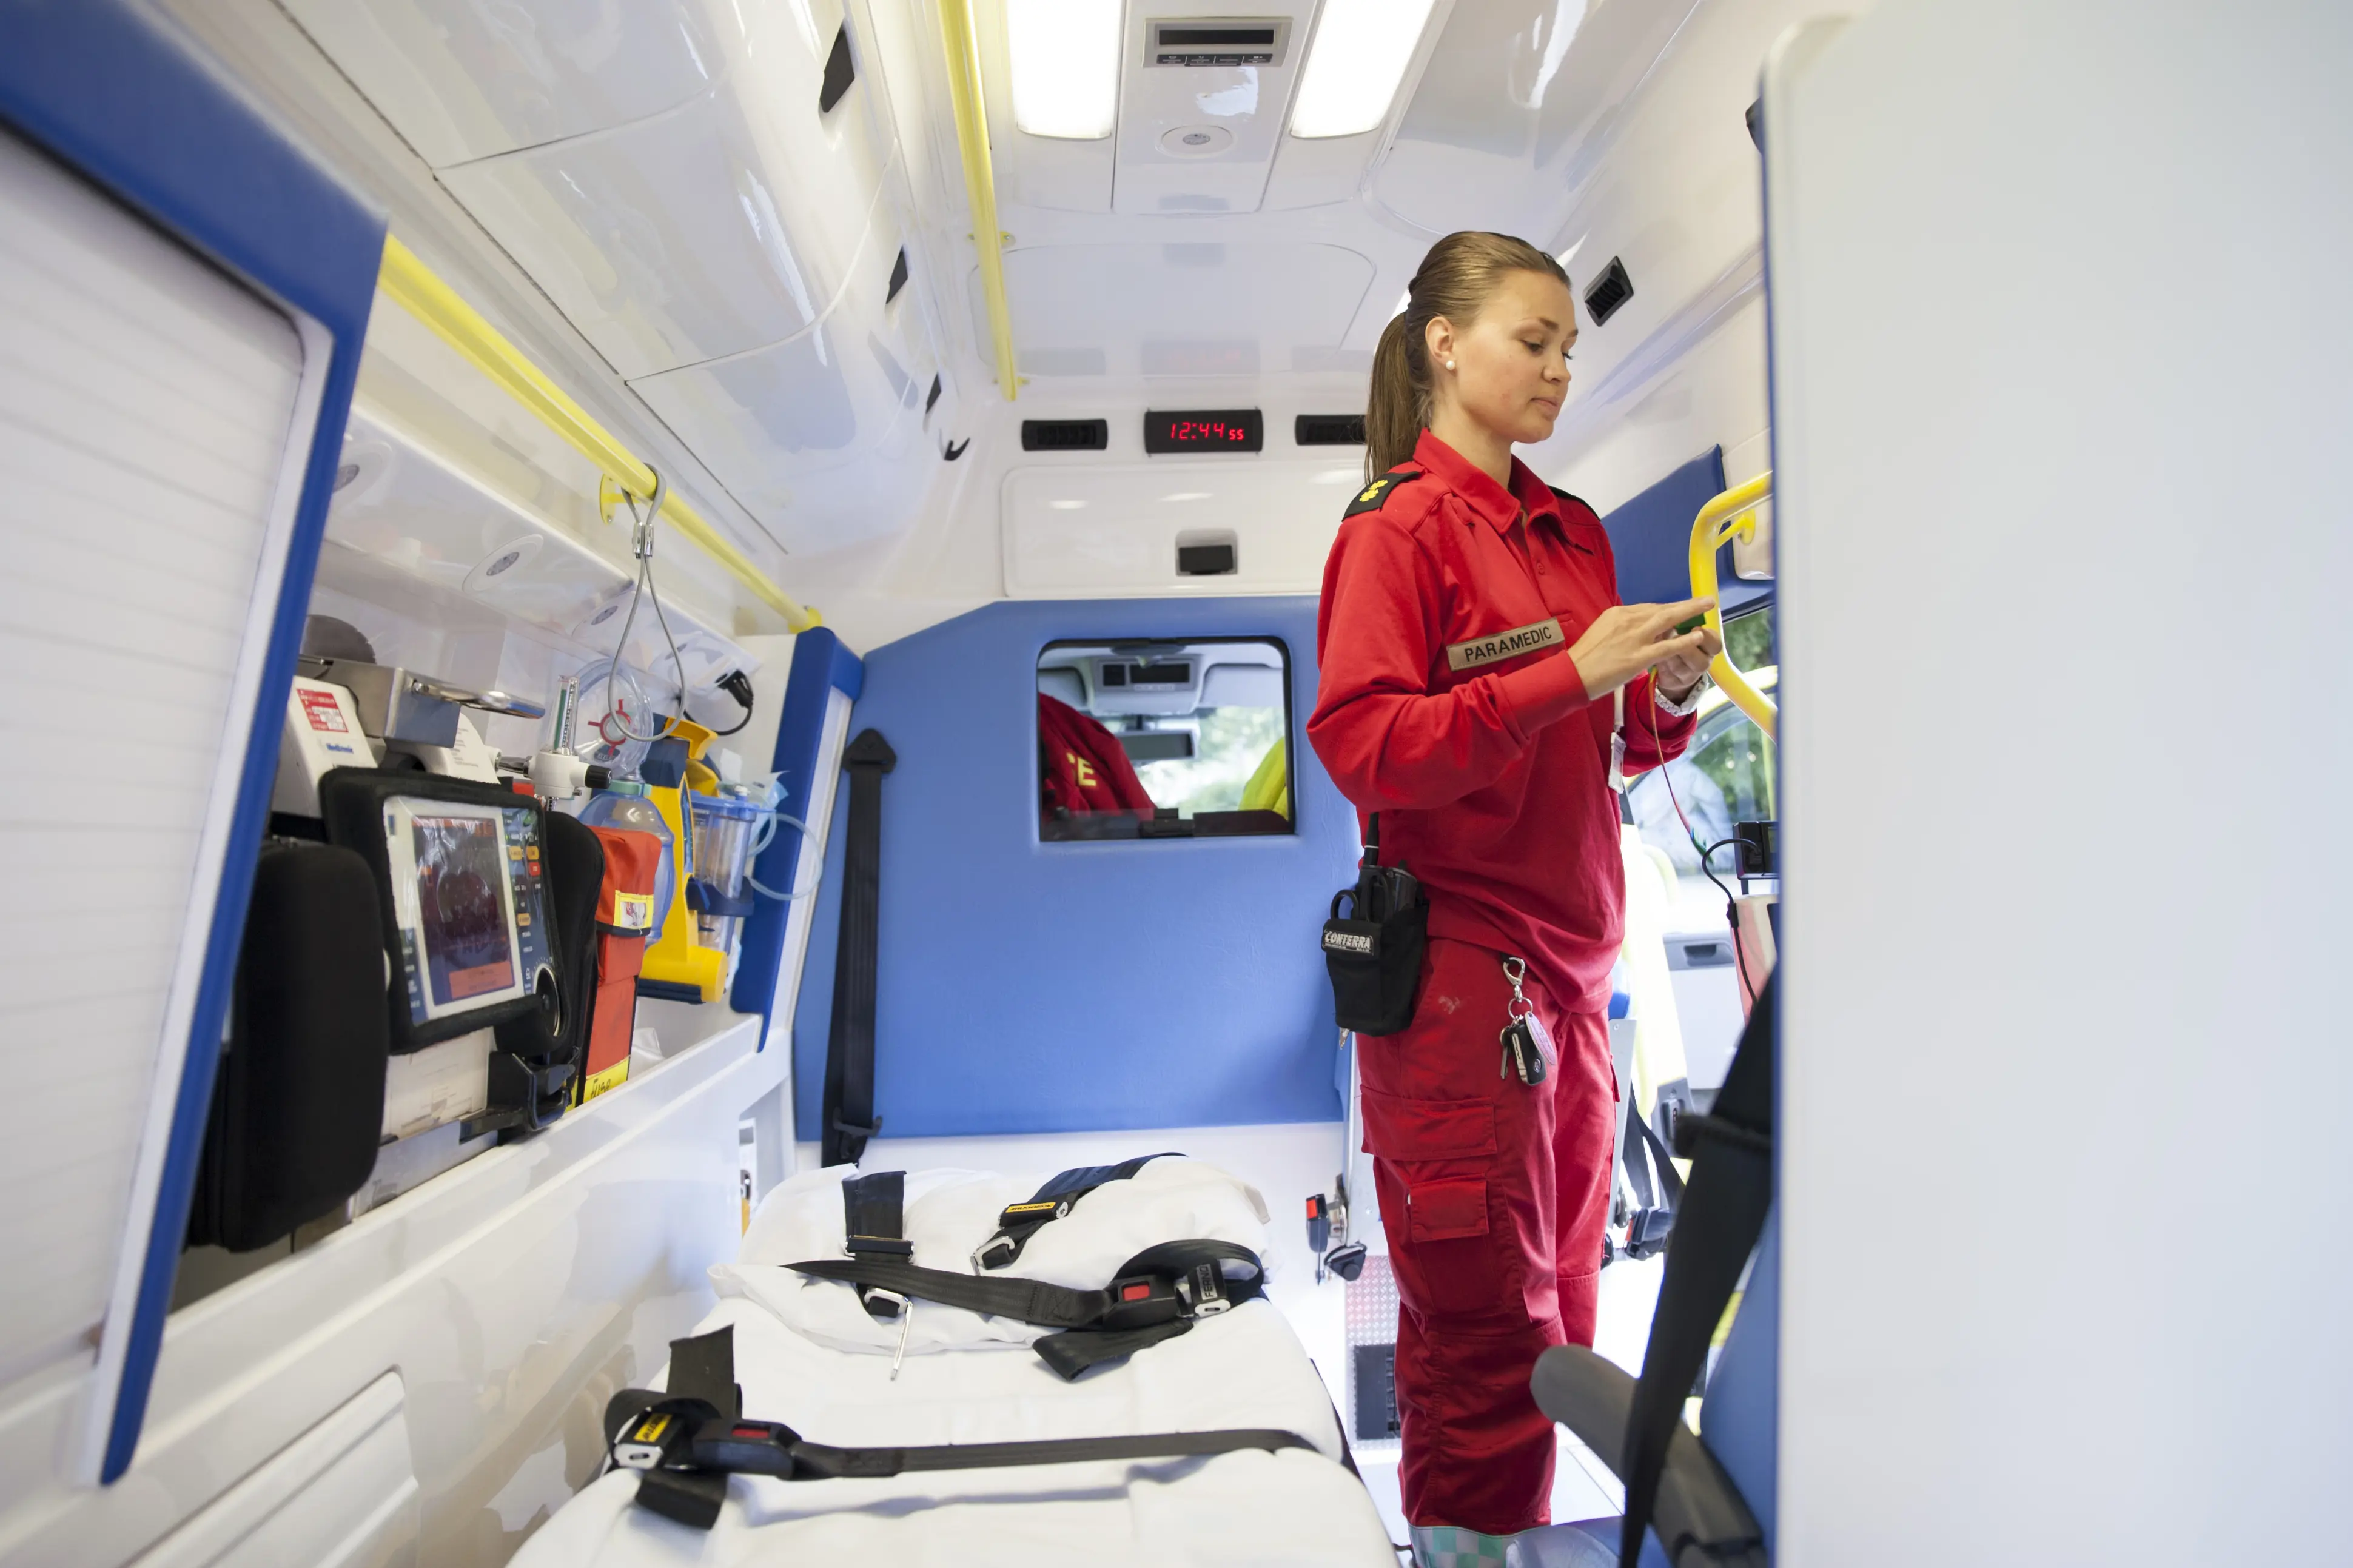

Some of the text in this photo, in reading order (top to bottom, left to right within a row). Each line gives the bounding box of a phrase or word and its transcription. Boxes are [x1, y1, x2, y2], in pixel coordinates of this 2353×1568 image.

[1171, 422, 1224, 440] 12:44
[1464, 626, 1552, 662] PARAMEDIC
[1324, 931, 1371, 949] CONTERRA
[1200, 1265, 1214, 1298] FERNO
